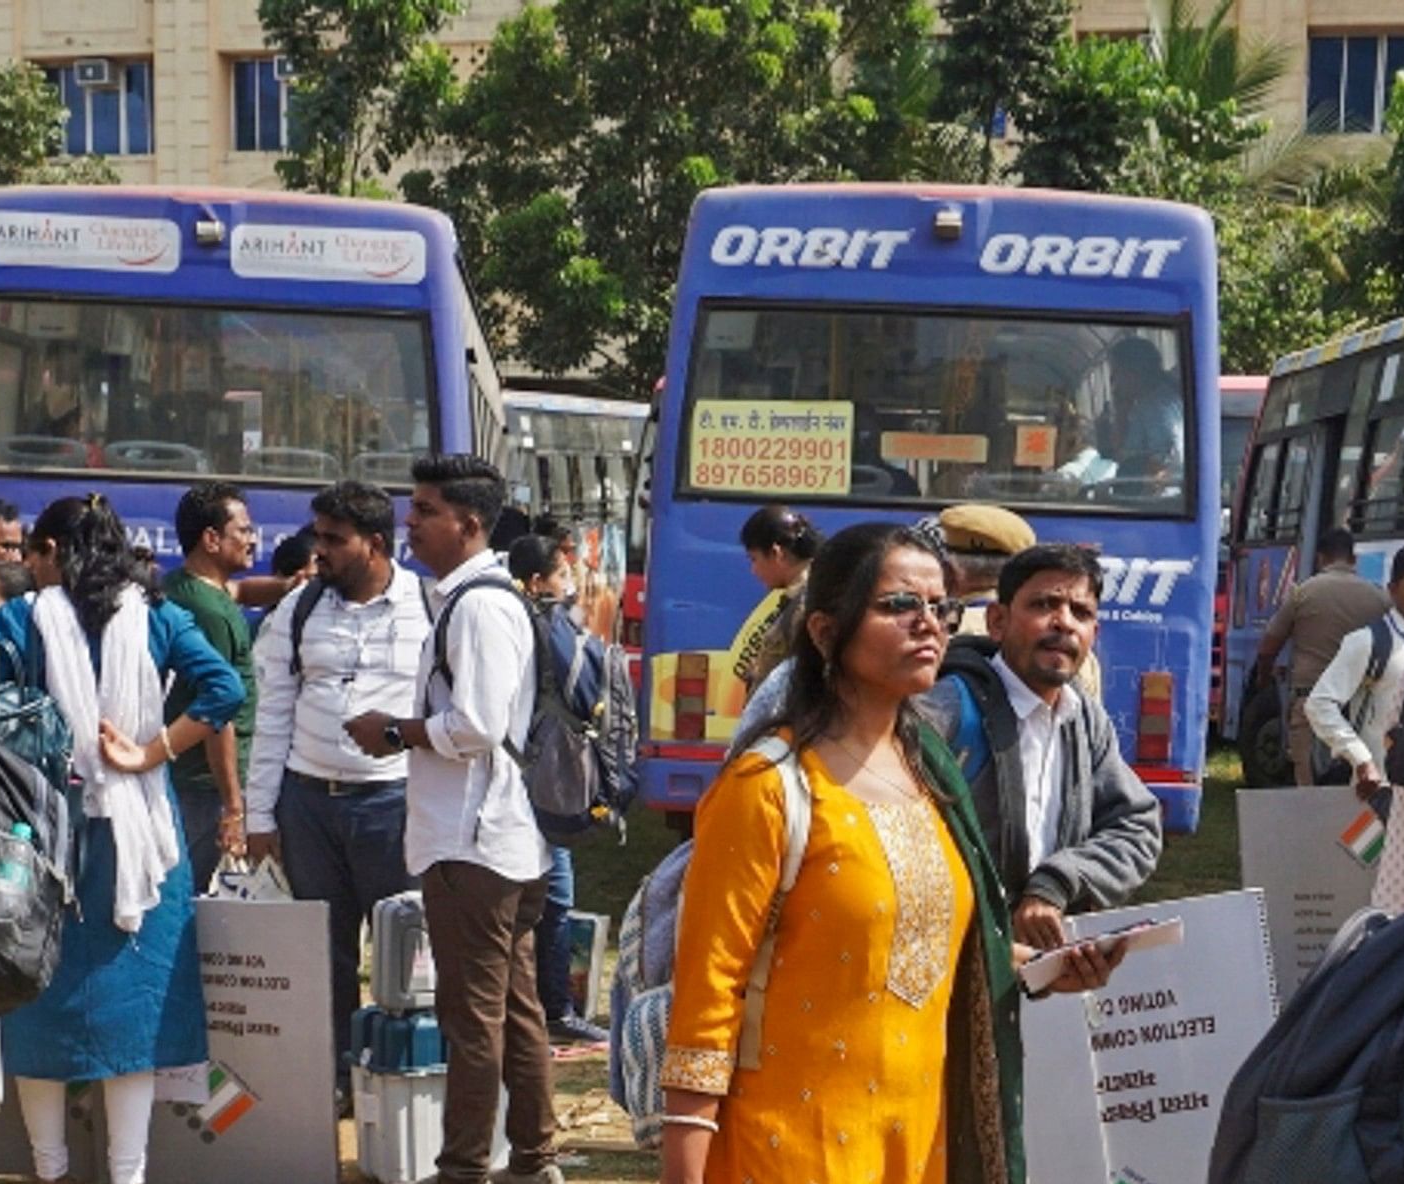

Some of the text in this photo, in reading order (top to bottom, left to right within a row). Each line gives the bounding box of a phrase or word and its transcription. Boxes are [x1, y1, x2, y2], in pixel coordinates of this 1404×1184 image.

[240, 232, 327, 256] ARIHANT
[711, 226, 911, 269] ORBIT
[979, 233, 1183, 278] ORBIT
[698, 437, 846, 461] 1800229901
[696, 463, 846, 488] 8976589671
[1095, 557, 1193, 605] BIT
[1118, 990, 1178, 1015] VOTING
[1139, 1016, 1217, 1046] ELECTION
